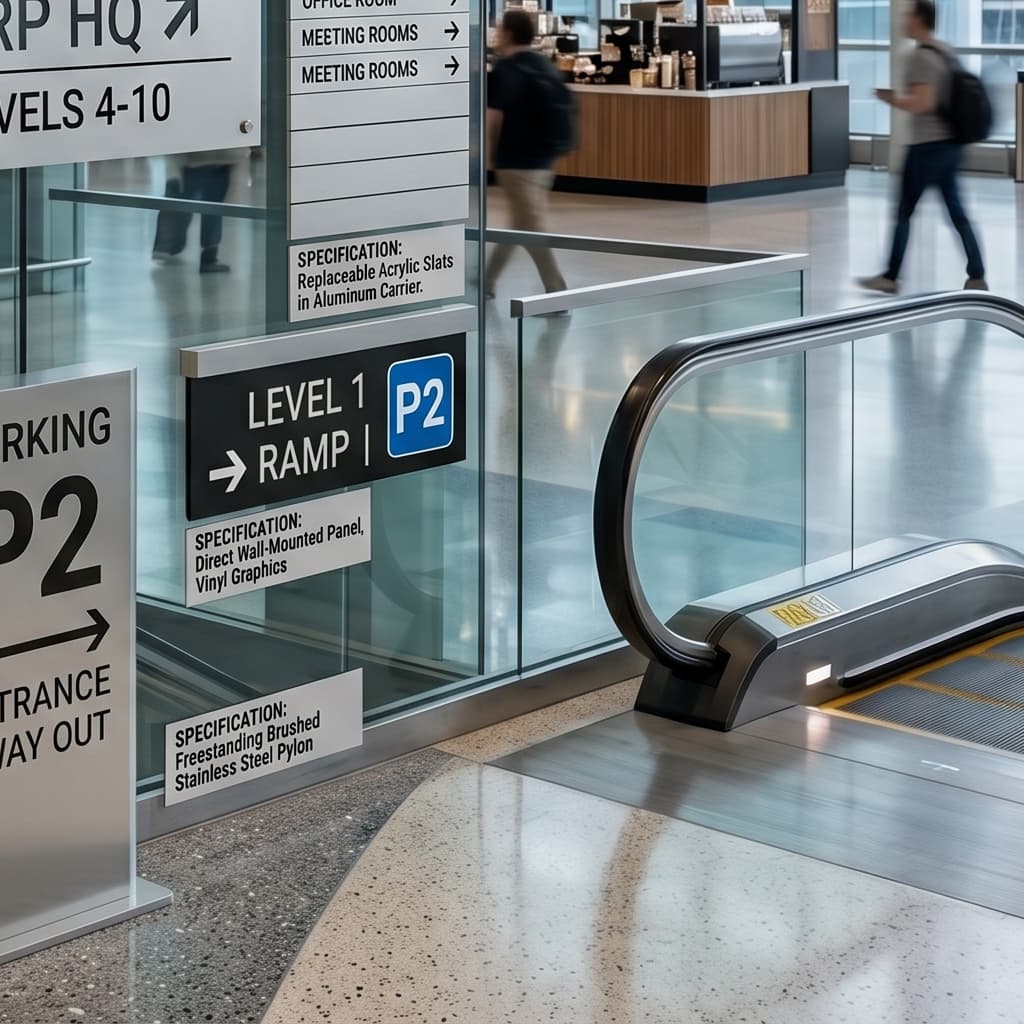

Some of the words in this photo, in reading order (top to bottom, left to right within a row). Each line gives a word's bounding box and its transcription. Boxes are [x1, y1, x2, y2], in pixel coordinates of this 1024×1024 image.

[303, 27, 364, 46] MEETING
[369, 24, 418, 43] ROOMS
[303, 63, 364, 83] MEETING
[369, 60, 418, 79] ROOMS
[96, 83, 170, 125] 4-10
[298, 240, 401, 267] SPECIFICATION:
[298, 264, 375, 291] Replaceable
[379, 258, 419, 281] Acrylic
[424, 254, 453, 271] Slats
[298, 295, 309, 310] in
[314, 288, 376, 308] Aluminum
[381, 279, 423, 298] Carrier.
[249, 378, 342, 429] LEVEL
[352, 373, 363, 408] 1
[397, 379, 444, 433] P2
[260, 430, 349, 483] RAMP
[196, 513, 301, 550] SPECIFICATION:
[196, 550, 233, 572] Direct
[238, 527, 323, 562] Wall-Mounted
[328, 517, 363, 541] Panel,
[196, 571, 227, 593] Vinyl
[232, 559, 287, 584] Graphics
[54, 709, 110, 752] OUT
[176, 701, 286, 747] SPECIFICATION:
[176, 732, 262, 770] Freestanding
[268, 710, 319, 742] Brushed
[176, 762, 236, 791] Stainless
[241, 746, 272, 771] Steel
[278, 738, 313, 762] Pylon
